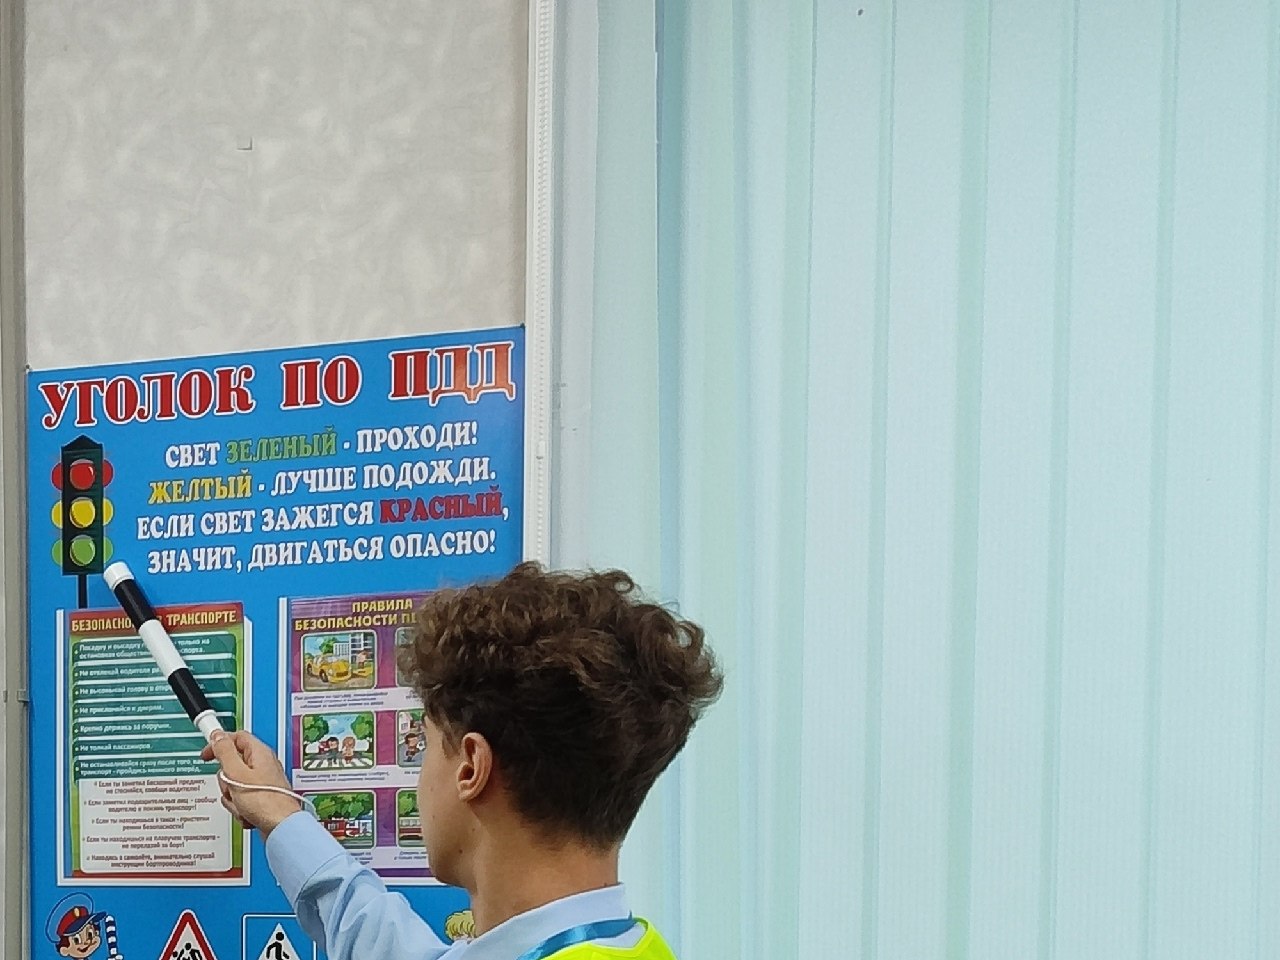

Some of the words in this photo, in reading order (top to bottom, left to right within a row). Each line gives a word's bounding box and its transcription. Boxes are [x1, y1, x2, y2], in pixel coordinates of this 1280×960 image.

[38, 364, 256, 430] УГОЛОК
[280, 355, 361, 410] ПО
[389, 341, 516, 406] ПДД
[165, 442, 221, 469] СВЕТ
[226, 423, 337, 464] ЗЕЛЕНЫЙ
[356, 421, 478, 453] ПРОХОДИ!
[148, 468, 252, 504] ЖЕЛТЫЙ
[270, 465, 357, 496] ЛУЧШЕ
[362, 457, 496, 489] ПОДОЖДИ.
[136, 516, 196, 540] ЕСЛИ
[200, 507, 257, 536] СВЕТ
[261, 501, 374, 532] ЗАЖЕГСЯ
[379, 485, 509, 524] КРАСНЫЙ,
[147, 548, 243, 574] ЗНАЧИТ,
[247, 537, 384, 570] ДВИГАТЬСЯ
[389, 530, 496, 559] ОПАСНО!
[71, 618, 132, 631] БЕЗОПАСНО
[166, 610, 237, 626] ТРАНСПОРТЕ
[295, 613, 397, 631] БЕЗОПАСНОСТИ
[352, 599, 413, 612] ПРАВИЛА
